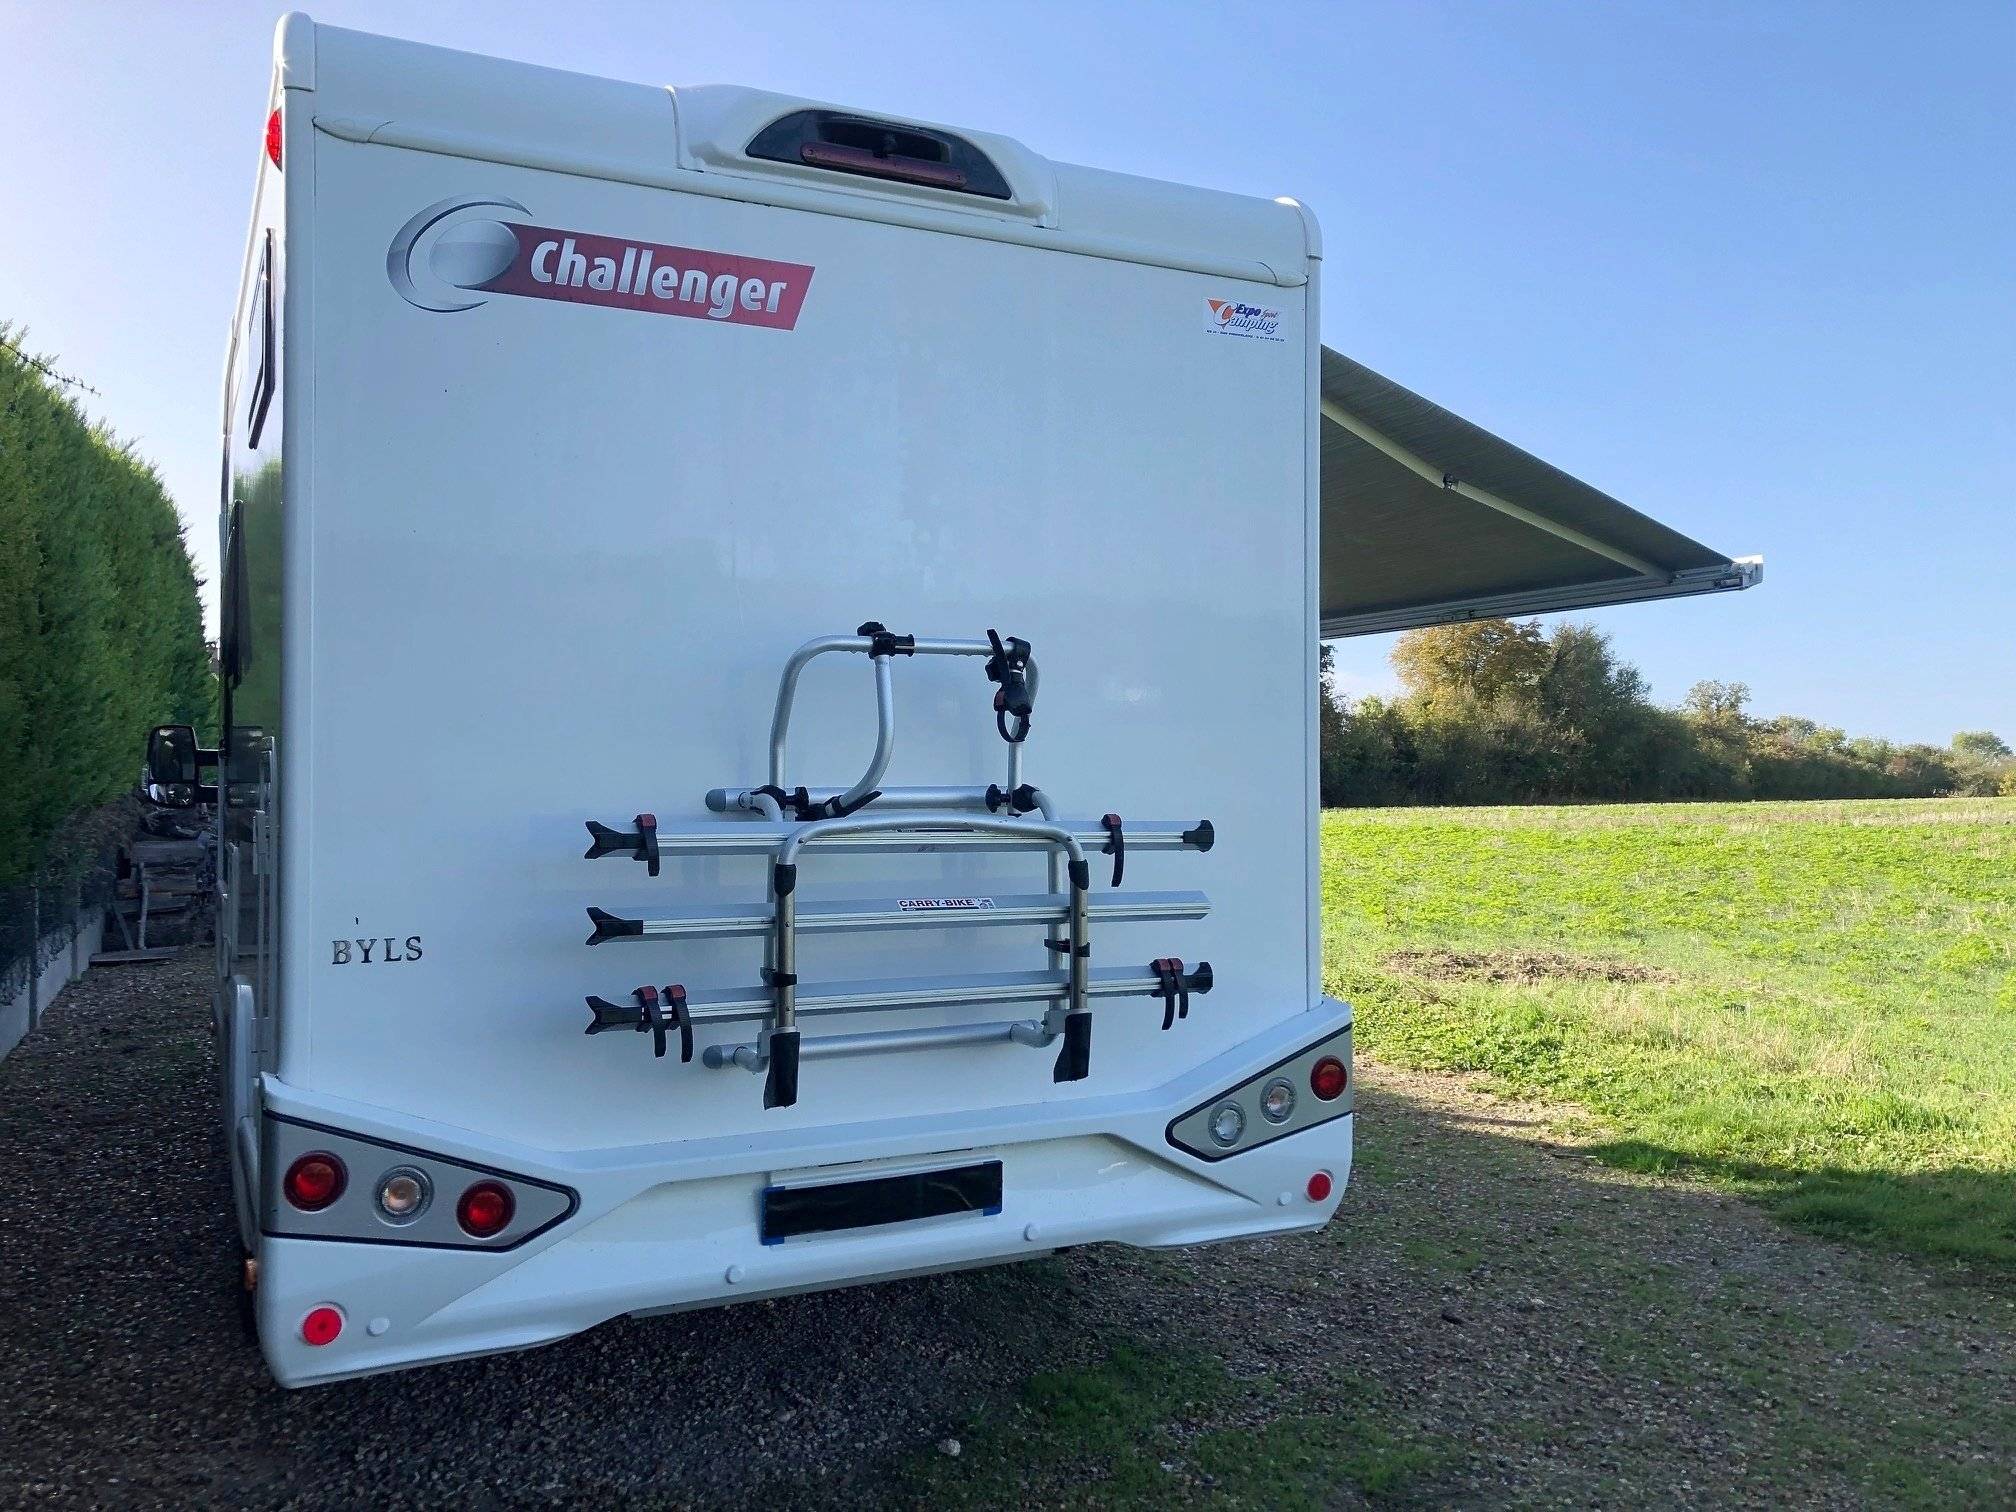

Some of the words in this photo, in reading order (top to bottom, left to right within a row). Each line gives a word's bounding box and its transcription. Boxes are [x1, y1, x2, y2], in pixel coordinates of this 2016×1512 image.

[530, 238, 788, 319] Challenger
[1235, 303, 1262, 319] Expo
[899, 898, 975, 908] CARRY-BIKE
[331, 935, 423, 965] BYLS
